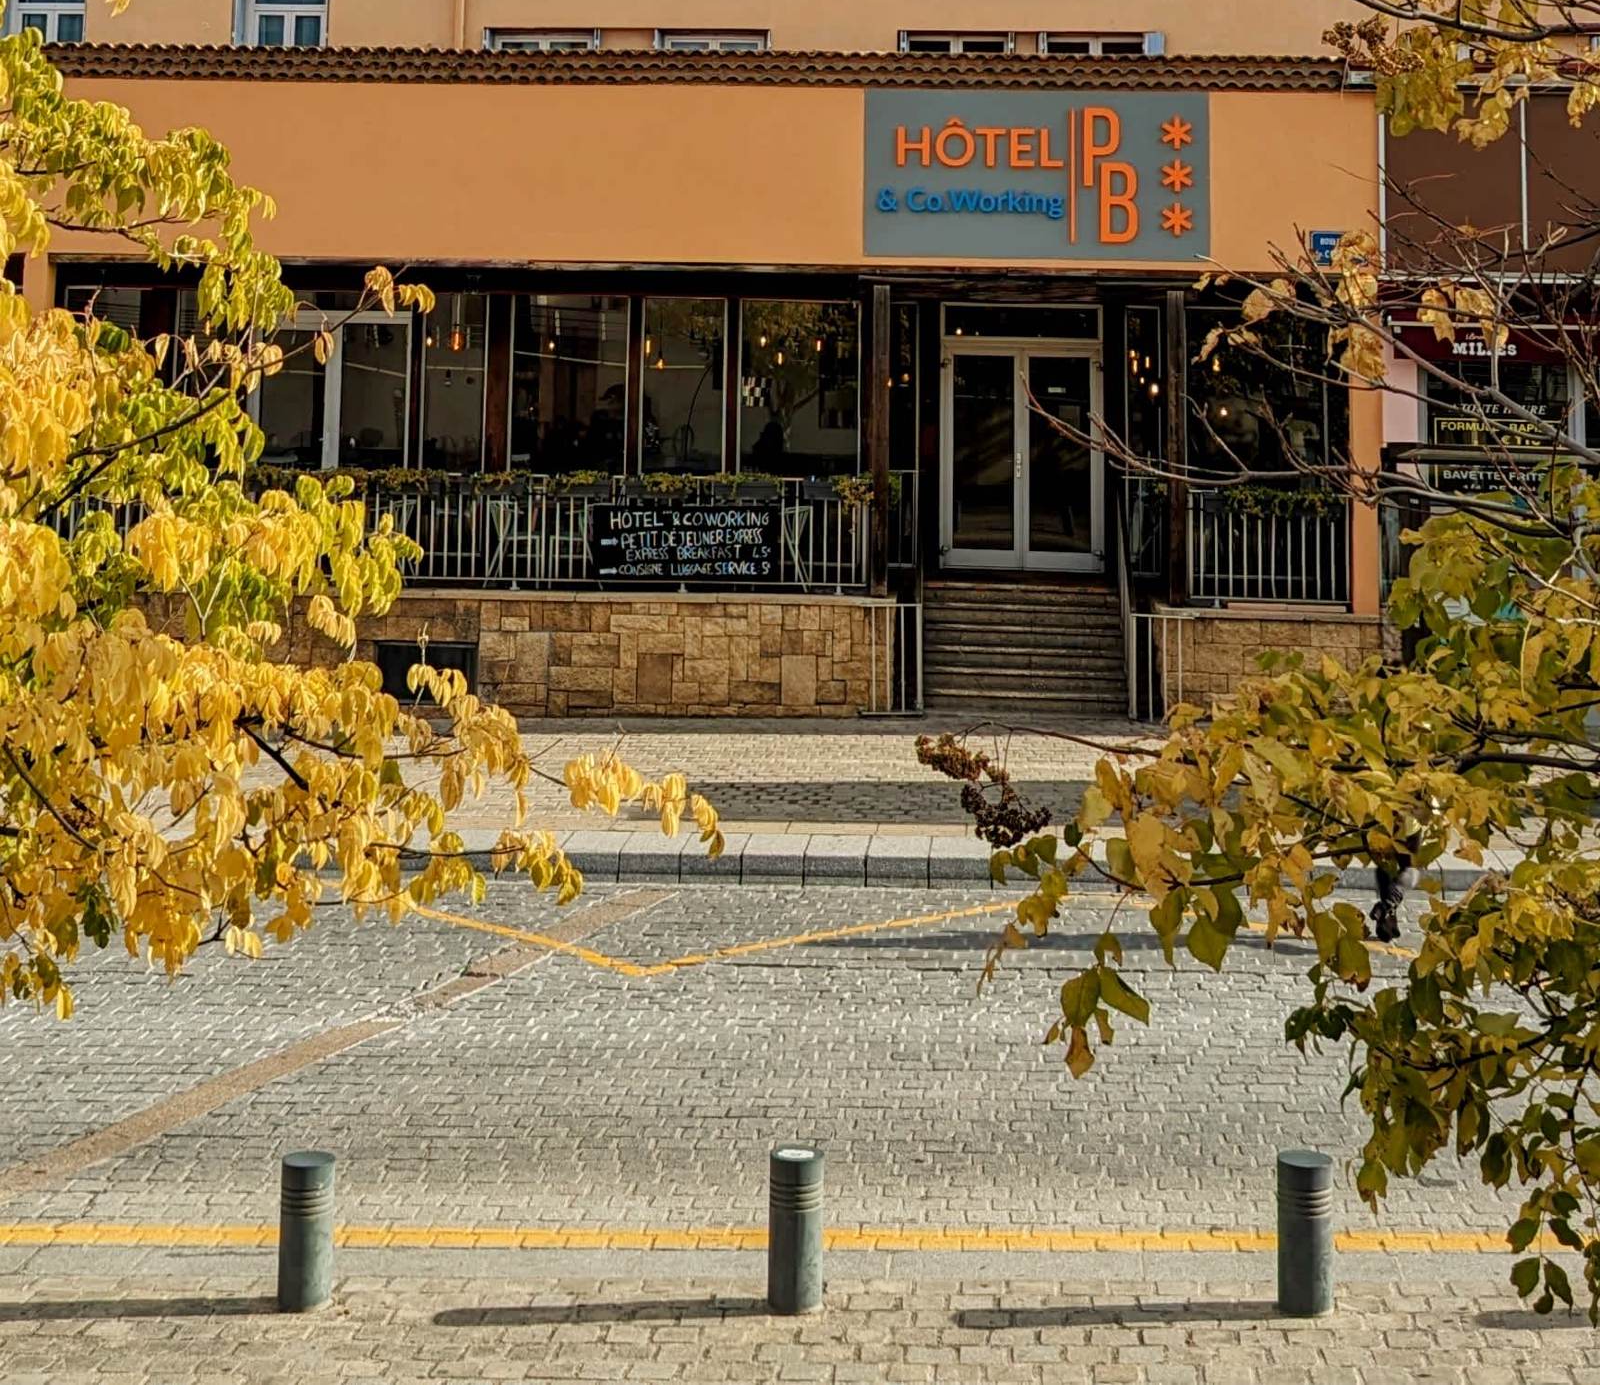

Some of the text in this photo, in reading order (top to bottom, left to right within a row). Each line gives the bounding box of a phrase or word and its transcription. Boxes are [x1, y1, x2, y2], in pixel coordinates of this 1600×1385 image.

[895, 117, 1064, 168] HÔTEL
[1443, 469, 1547, 482] BAVETTE FRITE
[620, 527, 763, 549] PETIT DÉJEUNER EXPRESS
[625, 546, 669, 562] EXPRESS
[676, 544, 742, 561] BREAKFAST
[618, 563, 664, 577] CONSIGNE
